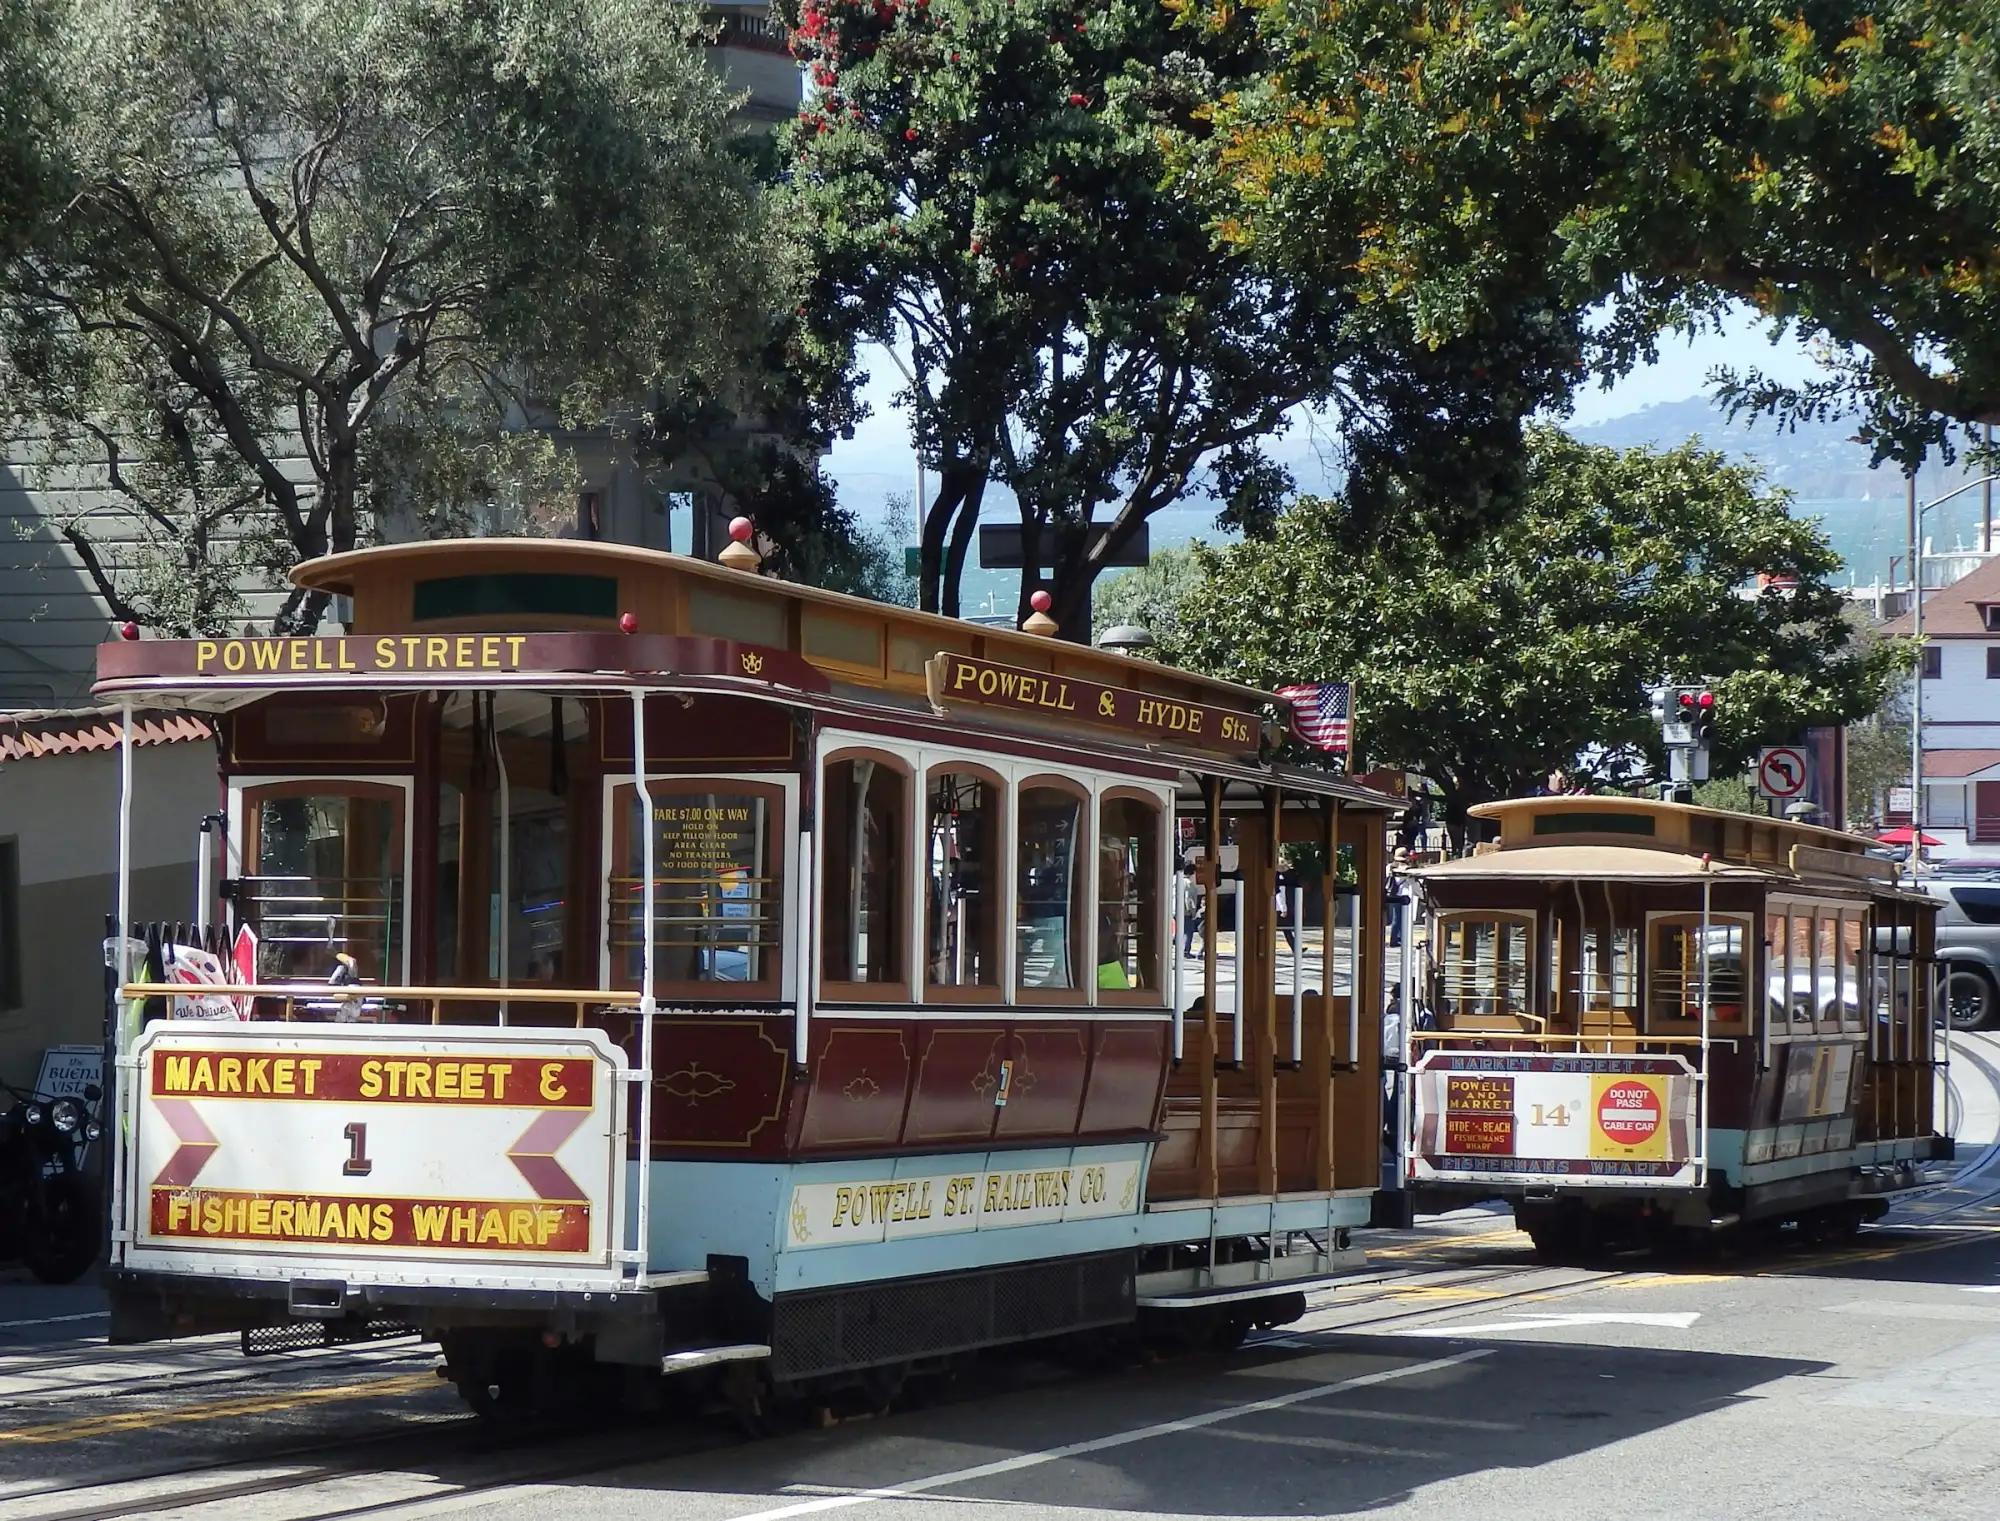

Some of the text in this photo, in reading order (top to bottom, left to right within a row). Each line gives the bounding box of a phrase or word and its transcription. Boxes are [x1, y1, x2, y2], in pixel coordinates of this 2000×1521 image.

[197, 636, 526, 671] POWELL STREET
[954, 663, 1250, 742] POWELL & HYDE Sts.
[654, 807, 748, 820] FARE $7.00 ONE WAY
[686, 851, 731, 859] TRANSFERS
[1451, 1056, 1531, 1070] MARKET
[1552, 1059, 1635, 1072] STREET
[165, 1056, 567, 1100] MARKET STREET &
[994, 1060, 1013, 1106] 1
[1451, 1081, 1511, 1092] POWELL
[1466, 1092, 1497, 1100] AND
[1610, 1089, 1649, 1100] DO NOT
[1450, 1100, 1511, 1110] MARKET
[1616, 1099, 1643, 1108] PASS
[1531, 1103, 1571, 1127] 14
[1449, 1120, 1470, 1132] HYDE
[1483, 1121, 1511, 1133] BEACH
[1603, 1121, 1655, 1132] CABLE CAR
[1454, 1134, 1505, 1143] FISHERMANS
[343, 1122, 373, 1176] 1
[1466, 1143, 1492, 1151] WHARF
[1442, 1156, 1662, 1176] FISHERMANS WHARF
[832, 1166, 1107, 1228] POWELL ST. RAILWAY CO.
[168, 1198, 562, 1245] FISHERMANS WHARF
